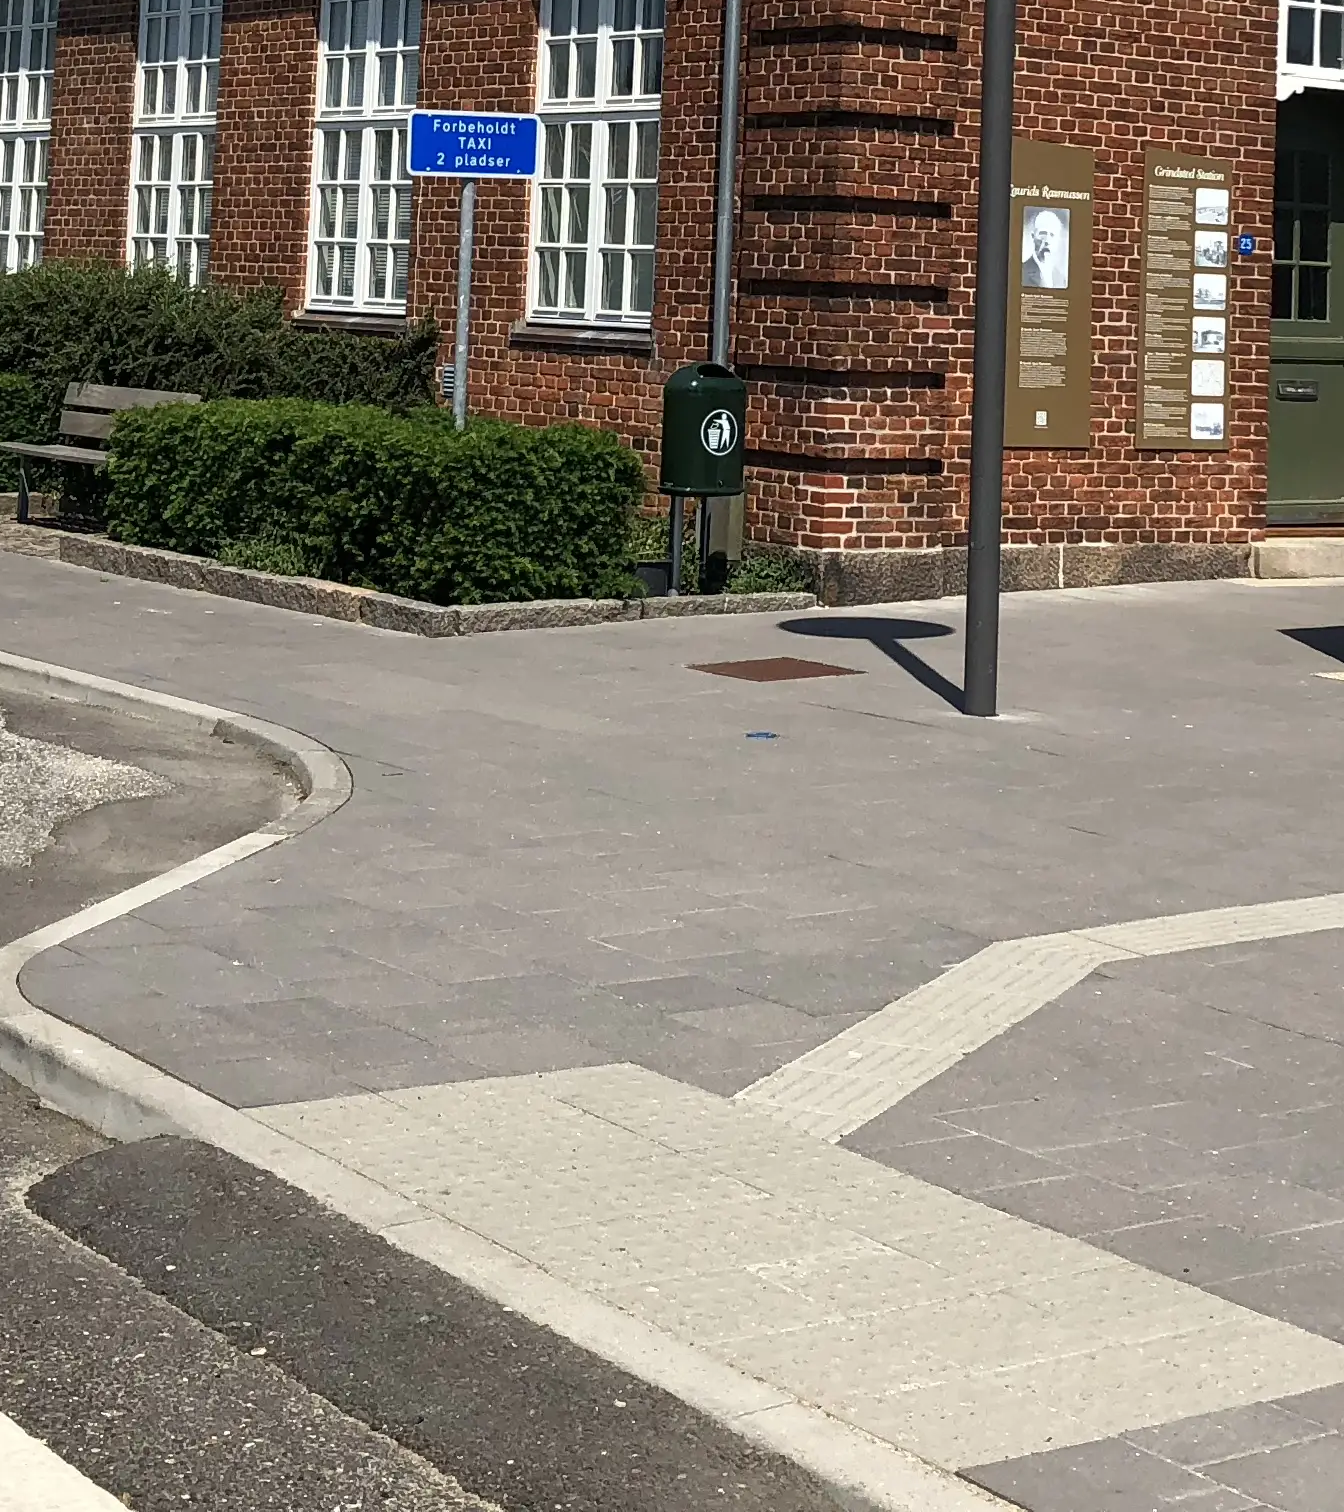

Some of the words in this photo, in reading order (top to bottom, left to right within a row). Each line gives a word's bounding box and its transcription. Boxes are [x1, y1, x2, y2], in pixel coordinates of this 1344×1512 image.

[433, 119, 516, 135] Forbeholdt
[458, 137, 492, 150] TAXI
[436, 152, 445, 166] 2
[455, 153, 511, 168] pladser
[1154, 165, 1196, 179] Grindsted
[1196, 168, 1225, 181] Station
[1041, 185, 1090, 200] Rasmussen
[1240, 238, 1252, 250] 25
